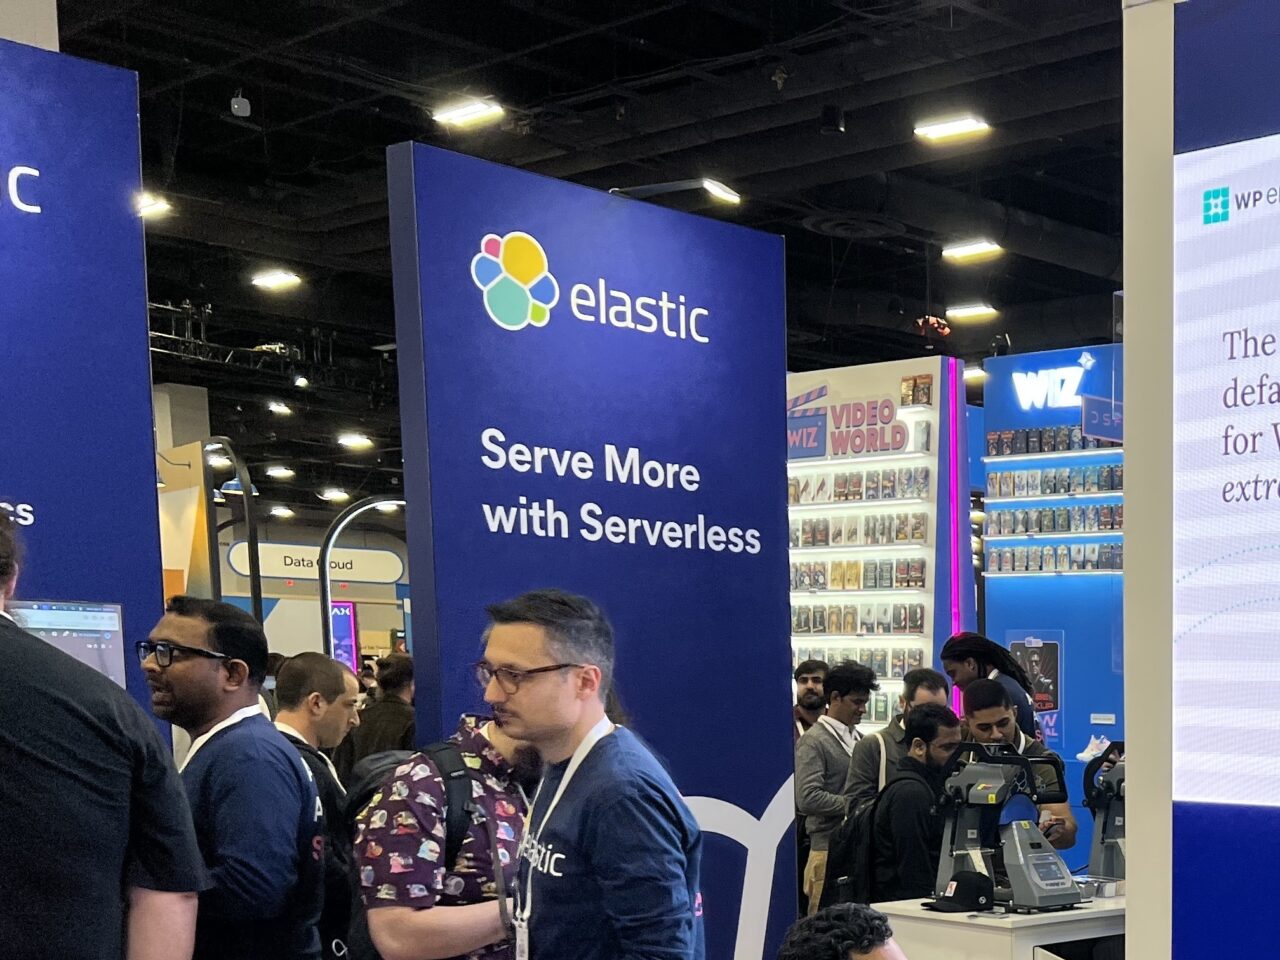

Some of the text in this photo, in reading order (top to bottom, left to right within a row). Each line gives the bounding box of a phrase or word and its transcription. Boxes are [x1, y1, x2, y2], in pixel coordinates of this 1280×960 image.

[1235, 191, 1263, 211] WP
[570, 277, 709, 343] elastic
[1222, 326, 1276, 361] The
[1012, 366, 1085, 411] WIZ
[831, 399, 895, 430] VIDEO
[788, 427, 818, 449] WIZ
[830, 424, 906, 456] WORLD
[1222, 424, 1263, 456] for
[481, 427, 700, 492] Serve More
[482, 495, 762, 555] with Serverless
[283, 555, 353, 570] Data oud
